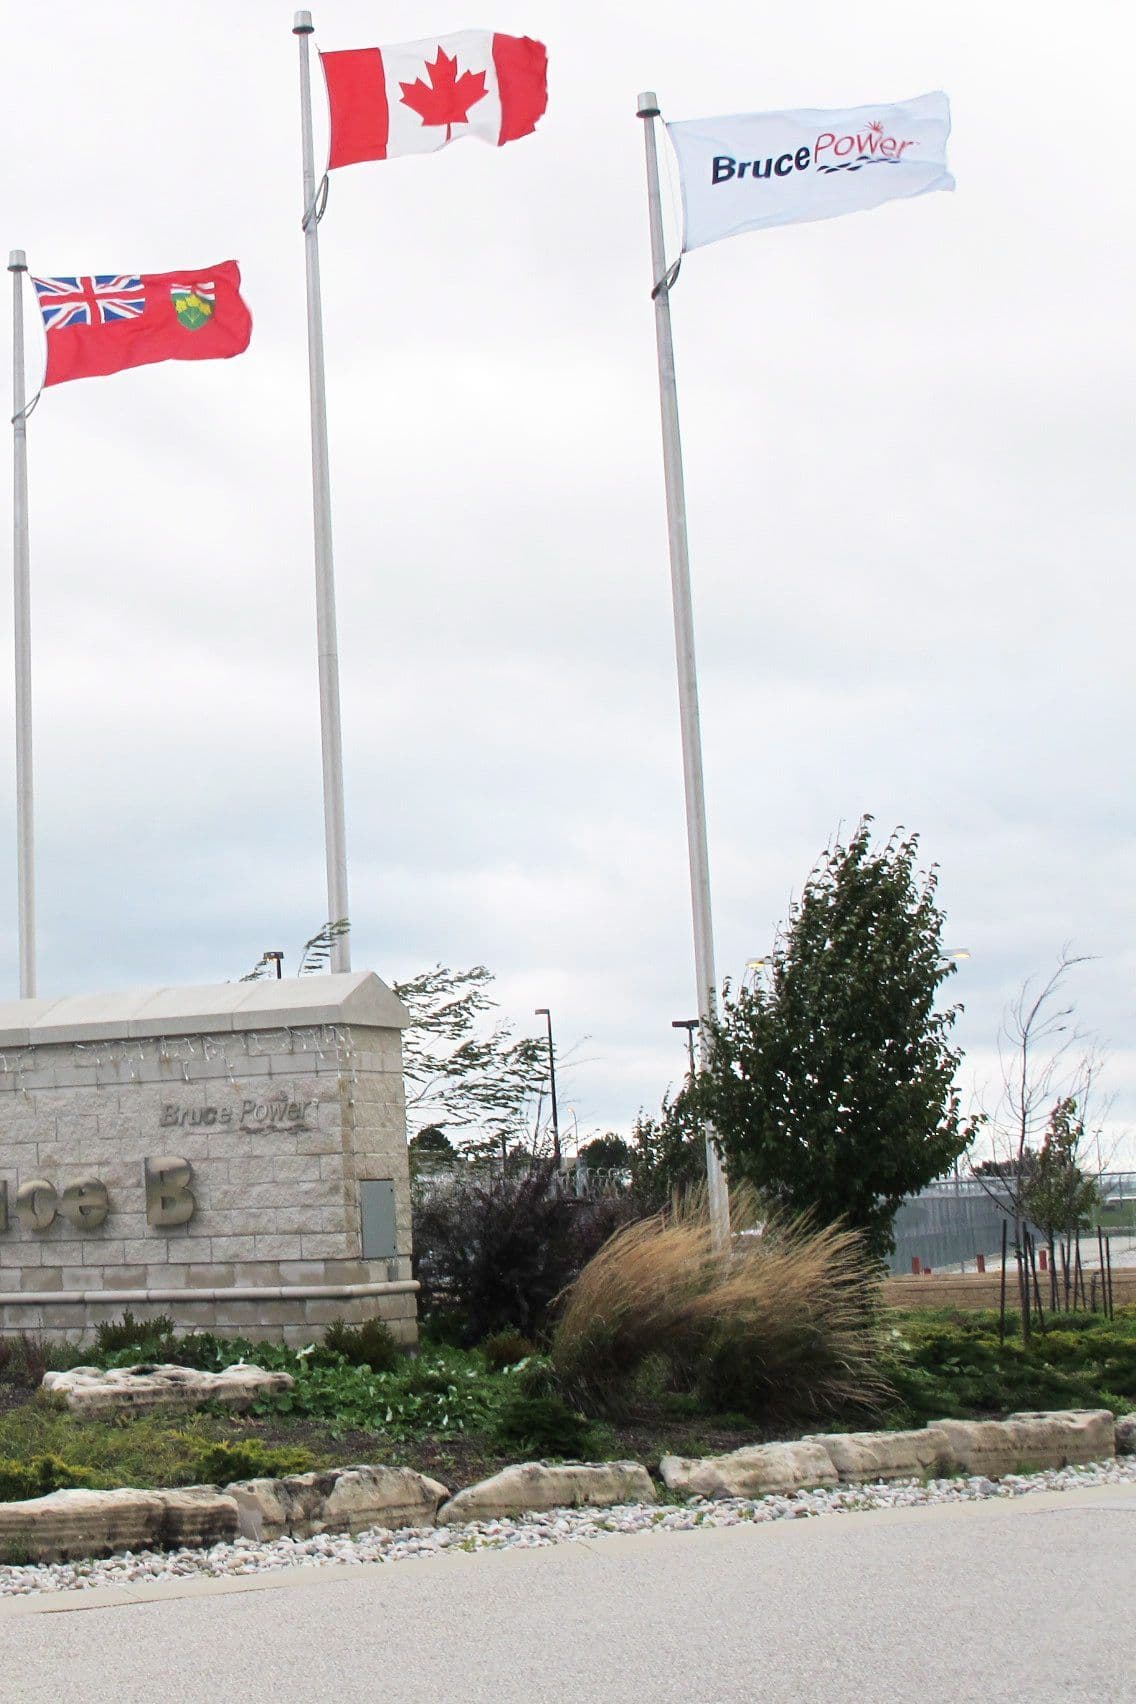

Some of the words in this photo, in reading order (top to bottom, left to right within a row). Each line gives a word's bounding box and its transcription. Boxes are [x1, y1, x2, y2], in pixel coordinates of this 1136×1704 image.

[712, 146, 810, 185] Bruce
[814, 131, 914, 164] Power
[160, 1104, 233, 1127] Bruce
[239, 1099, 312, 1123] Power
[144, 1156, 198, 1226] B
